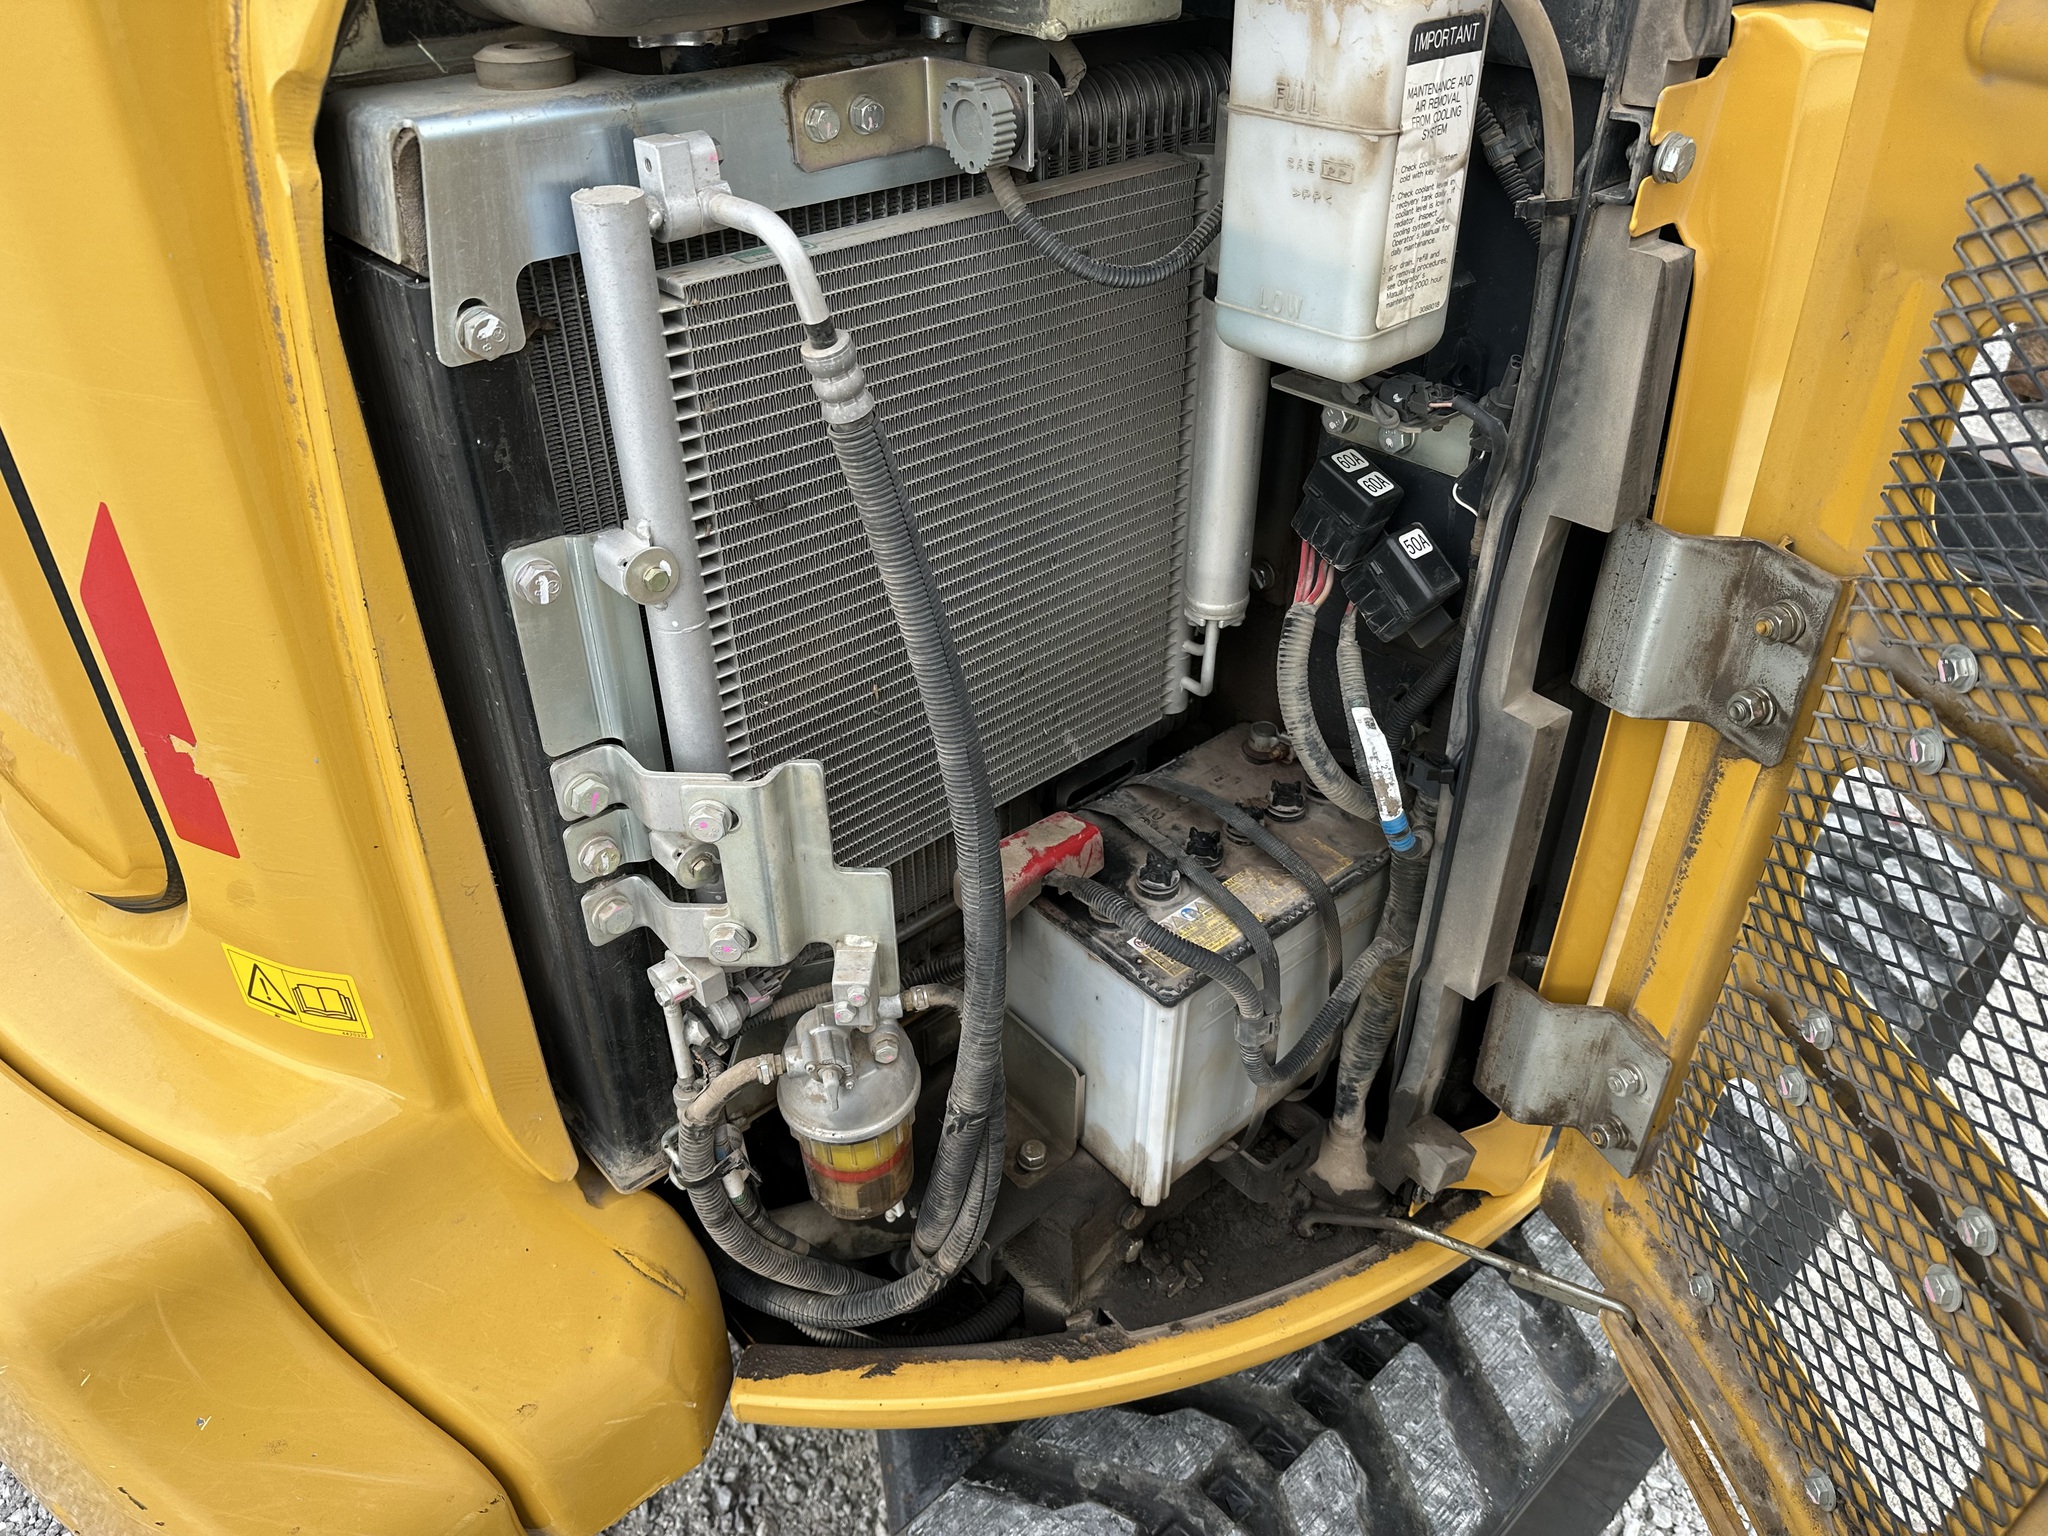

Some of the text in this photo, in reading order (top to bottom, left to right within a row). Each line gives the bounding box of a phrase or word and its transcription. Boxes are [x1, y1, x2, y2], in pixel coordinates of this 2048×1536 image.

[1414, 23, 1480, 53] IMPORTANT
[1407, 74, 1474, 100] MAINTENANCE AND
[1274, 79, 1320, 117] FULL
[1415, 91, 1461, 113] AIR REMOVAL
[1411, 106, 1462, 128] FROM COOLING
[1421, 123, 1448, 141] SYSTEM
[1400, 174, 1411, 183] cold
[1412, 170, 1424, 179] with
[1425, 168, 1435, 176] key
[1401, 162, 1416, 174] Check
[1419, 158, 1436, 170] cooling
[1398, 189, 1413, 200] Check
[1415, 183, 1434, 195] coolant
[1436, 179, 1448, 189] level
[1395, 207, 1414, 219] coolant
[1415, 203, 1428, 212] level
[1396, 197, 1419, 210] recovery
[1421, 193, 1433, 202] tank
[1418, 210, 1438, 221] inspect
[1392, 226, 1411, 238] cooling
[1434, 216, 1446, 225] See
[1421, 226, 1440, 237] Manual
[1442, 223, 1450, 231] for
[1389, 264, 1399, 272] For
[1430, 249, 1440, 259] and
[1391, 247, 1402, 256] daily
[1396, 267, 1415, 279] removal
[1386, 275, 1444, 300] Manual for 2000 hour
[1387, 282, 1396, 291] see
[1259, 286, 1304, 320] LOW
[1336, 452, 1365, 469] 60A
[1362, 474, 1391, 493] 60A
[1403, 533, 1431, 555] 50A
